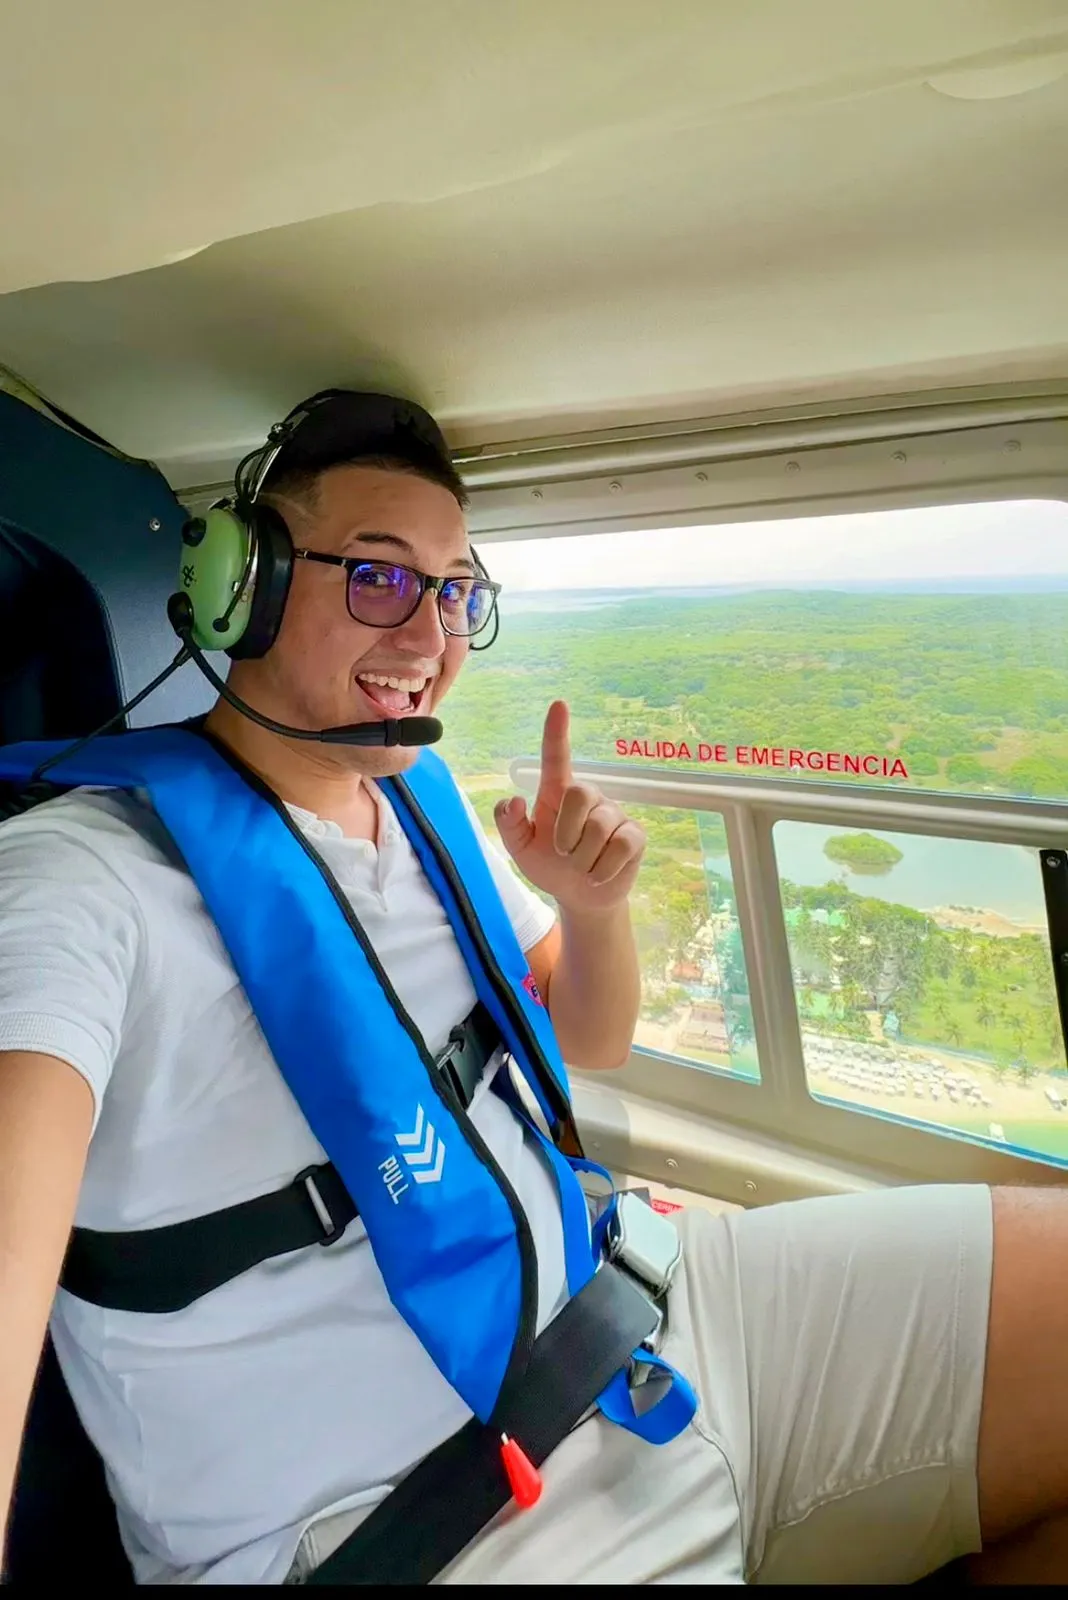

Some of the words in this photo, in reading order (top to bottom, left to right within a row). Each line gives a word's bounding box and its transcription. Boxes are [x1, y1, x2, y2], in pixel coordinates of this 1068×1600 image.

[615, 738, 691, 759] SALIDA
[698, 743, 728, 762] DE
[736, 746, 909, 778] EMERGENCIA
[377, 1154, 409, 1205] PULL
